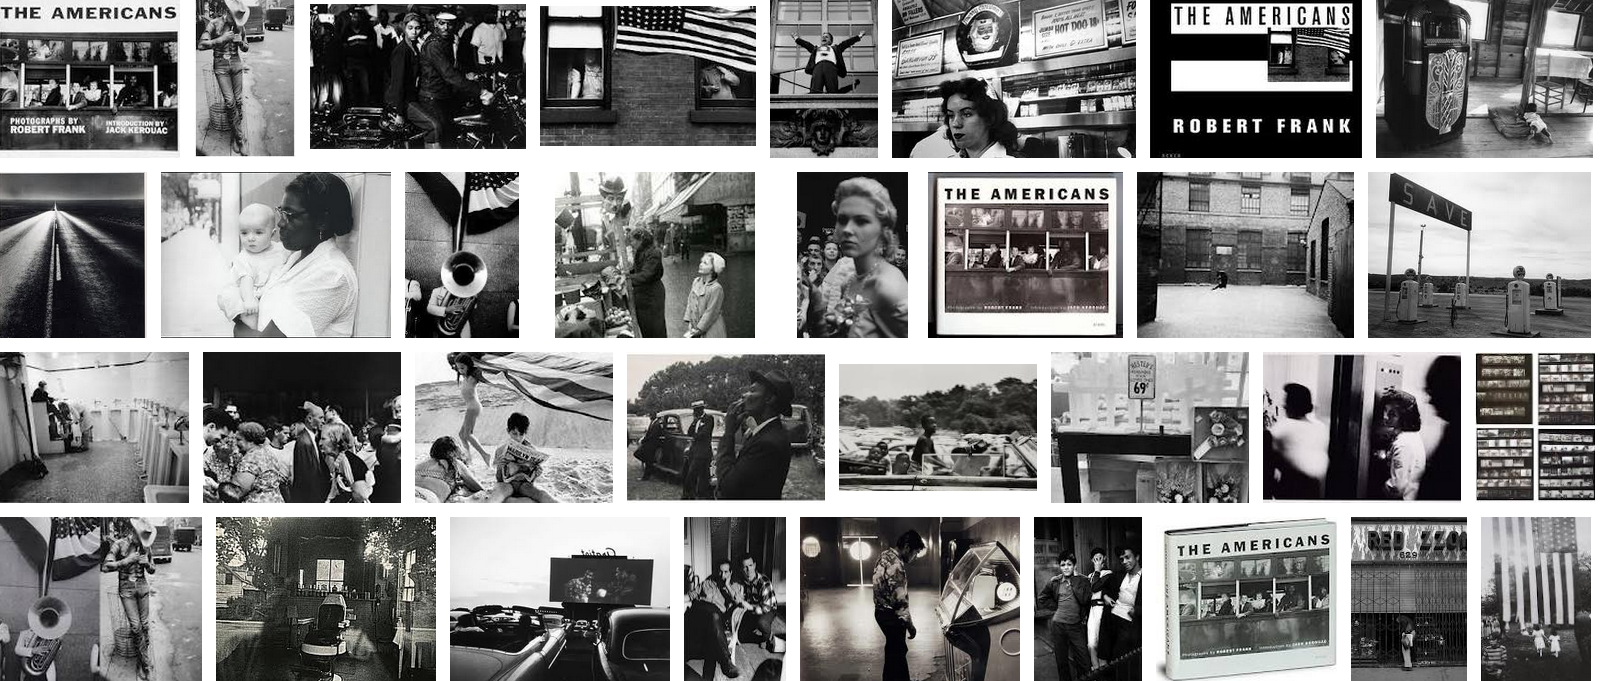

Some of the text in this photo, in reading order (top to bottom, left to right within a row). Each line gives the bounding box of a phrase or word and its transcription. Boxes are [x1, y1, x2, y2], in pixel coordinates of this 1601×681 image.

[0, 6, 177, 19] THE AMERICANS
[1174, 6, 1350, 26] THE AMERICANS
[1054, 22, 1070, 34] HOT
[10, 125, 86, 134] ROBERT FRANK
[1173, 118, 1351, 134] ROBERT FRANK
[945, 188, 1109, 200] THE AMERICANS
[1403, 182, 1468, 226] SAVE
[1178, 534, 1330, 557] THE AMERICANS
[1368, 530, 1404, 551] RED
